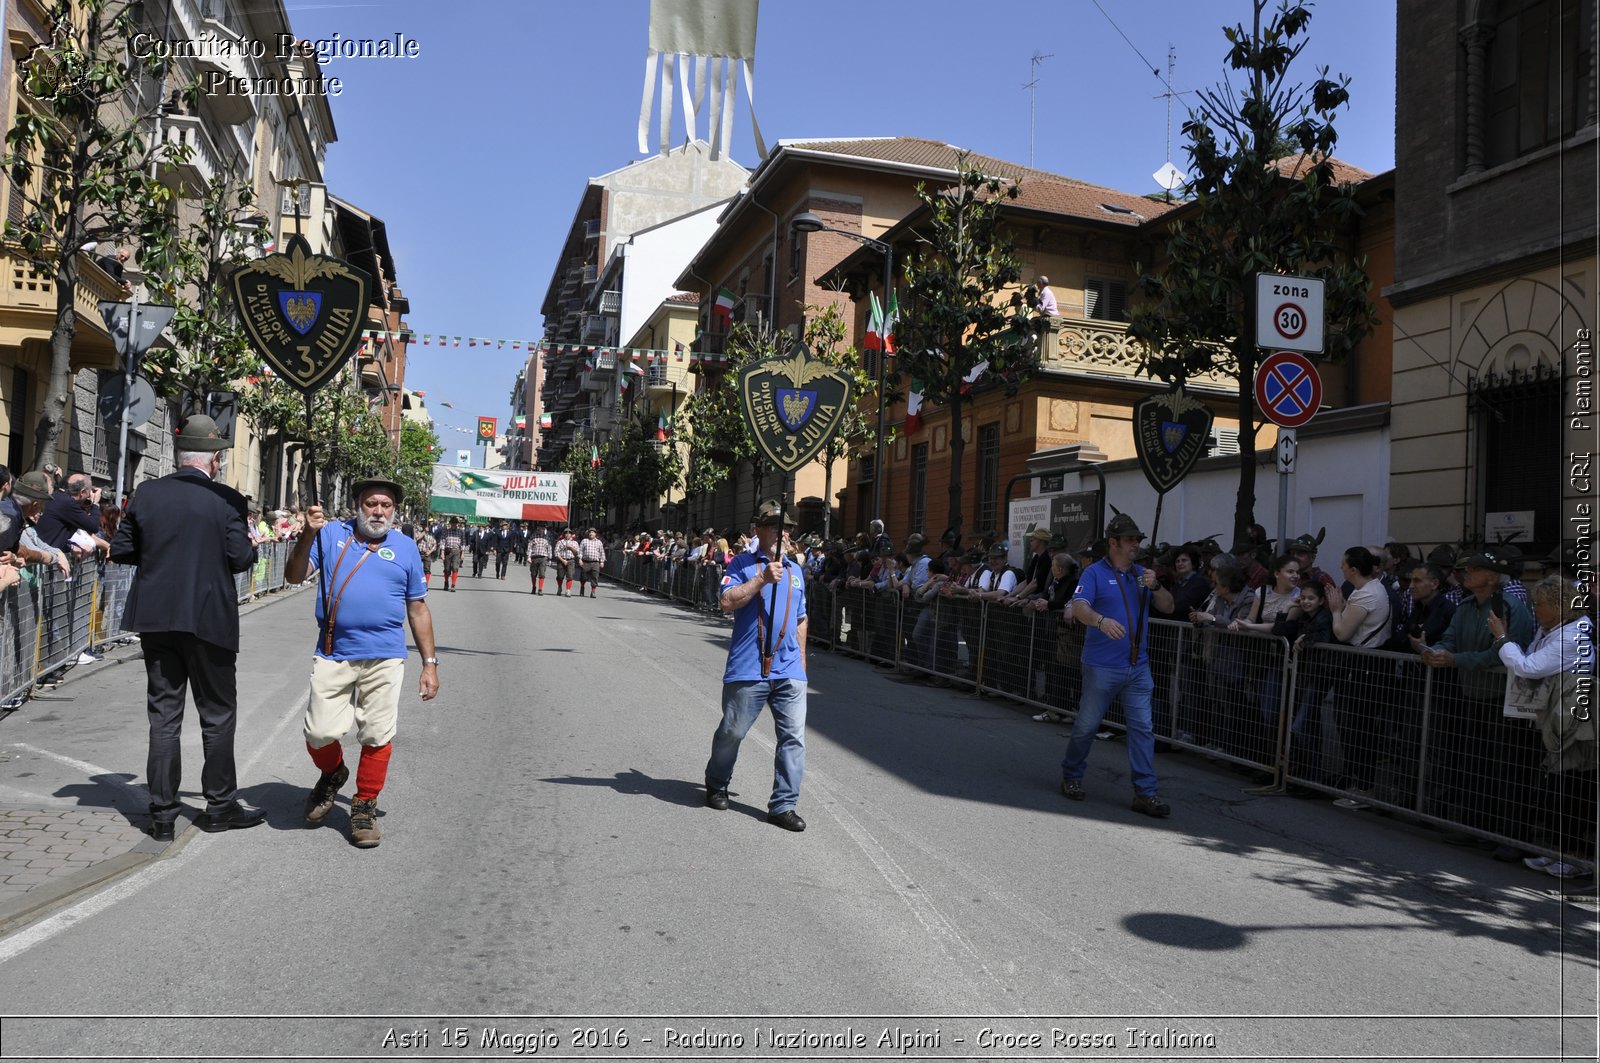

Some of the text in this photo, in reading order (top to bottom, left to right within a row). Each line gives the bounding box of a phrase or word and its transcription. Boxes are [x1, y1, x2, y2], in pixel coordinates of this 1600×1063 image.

[1273, 285, 1309, 298] zona
[247, 295, 274, 342] ALPINA
[257, 284, 291, 346] DIVISIONE
[1281, 312, 1299, 330] 30
[296, 308, 353, 377] 3 JULIA
[751, 391, 770, 432] ALPINA
[761, 381, 783, 435] DIVISIONE
[781, 405, 836, 463] 3 JULIA
[502, 475, 537, 490] JULIA
[503, 490, 558, 502] PORDENONE
